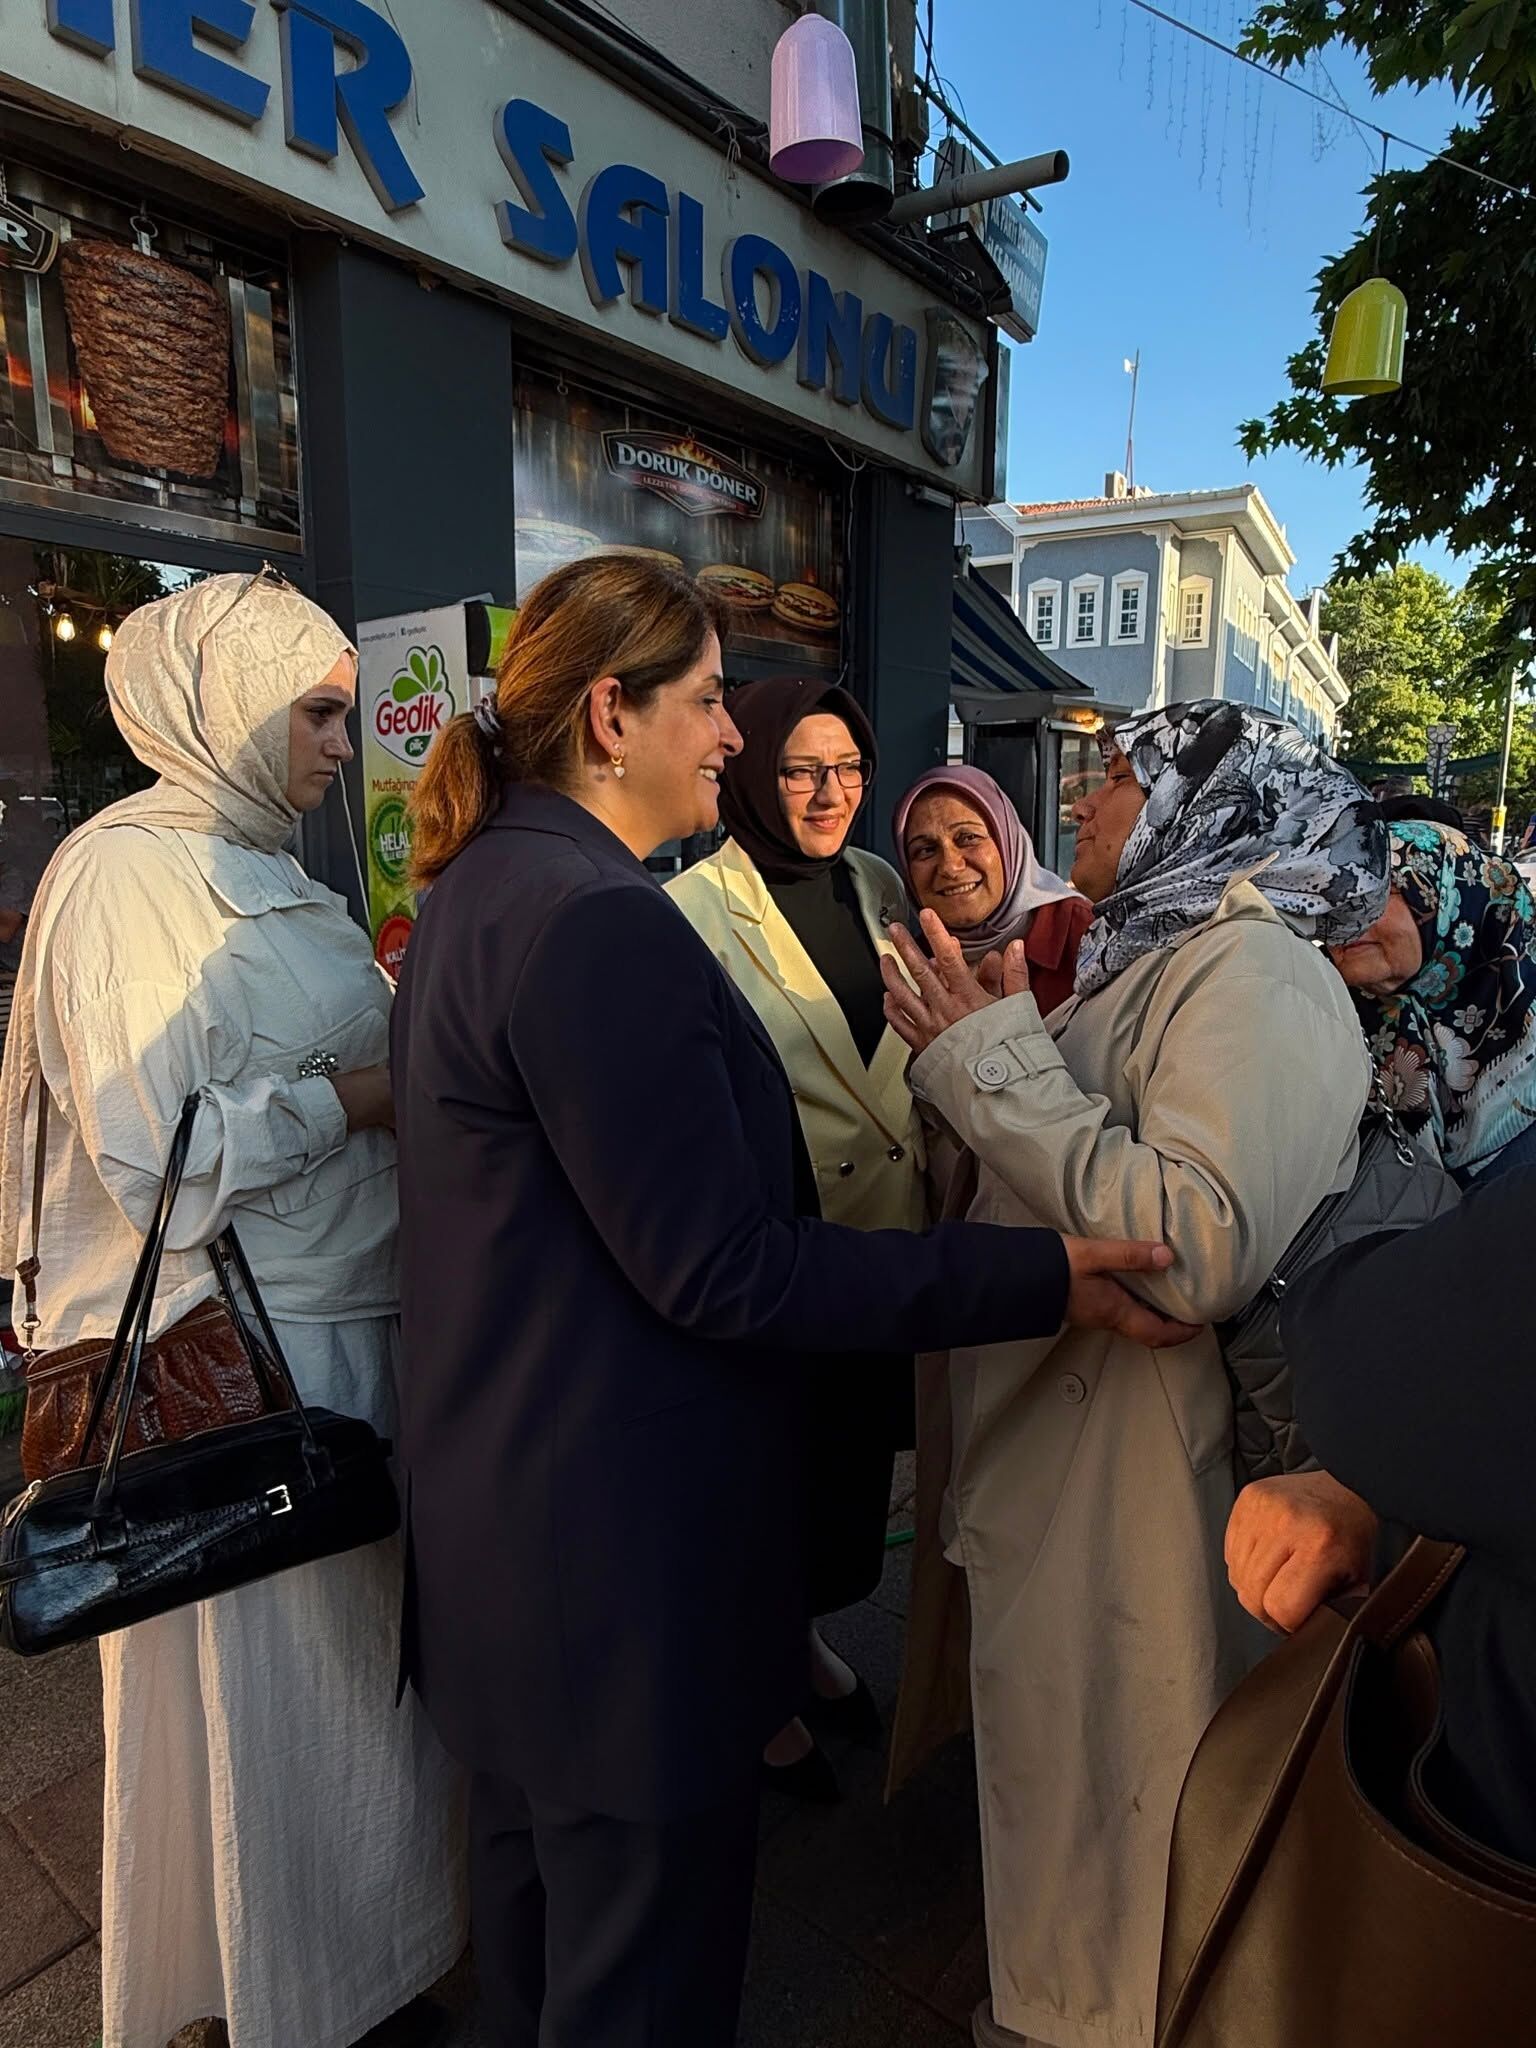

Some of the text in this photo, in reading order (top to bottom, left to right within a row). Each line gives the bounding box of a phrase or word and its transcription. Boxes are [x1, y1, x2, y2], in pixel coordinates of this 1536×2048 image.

[46, 0, 917, 431] ER SALONU
[616, 441, 690, 480] DORUK
[695, 467, 758, 506] DÖNER
[376, 694, 445, 736] Gedik
